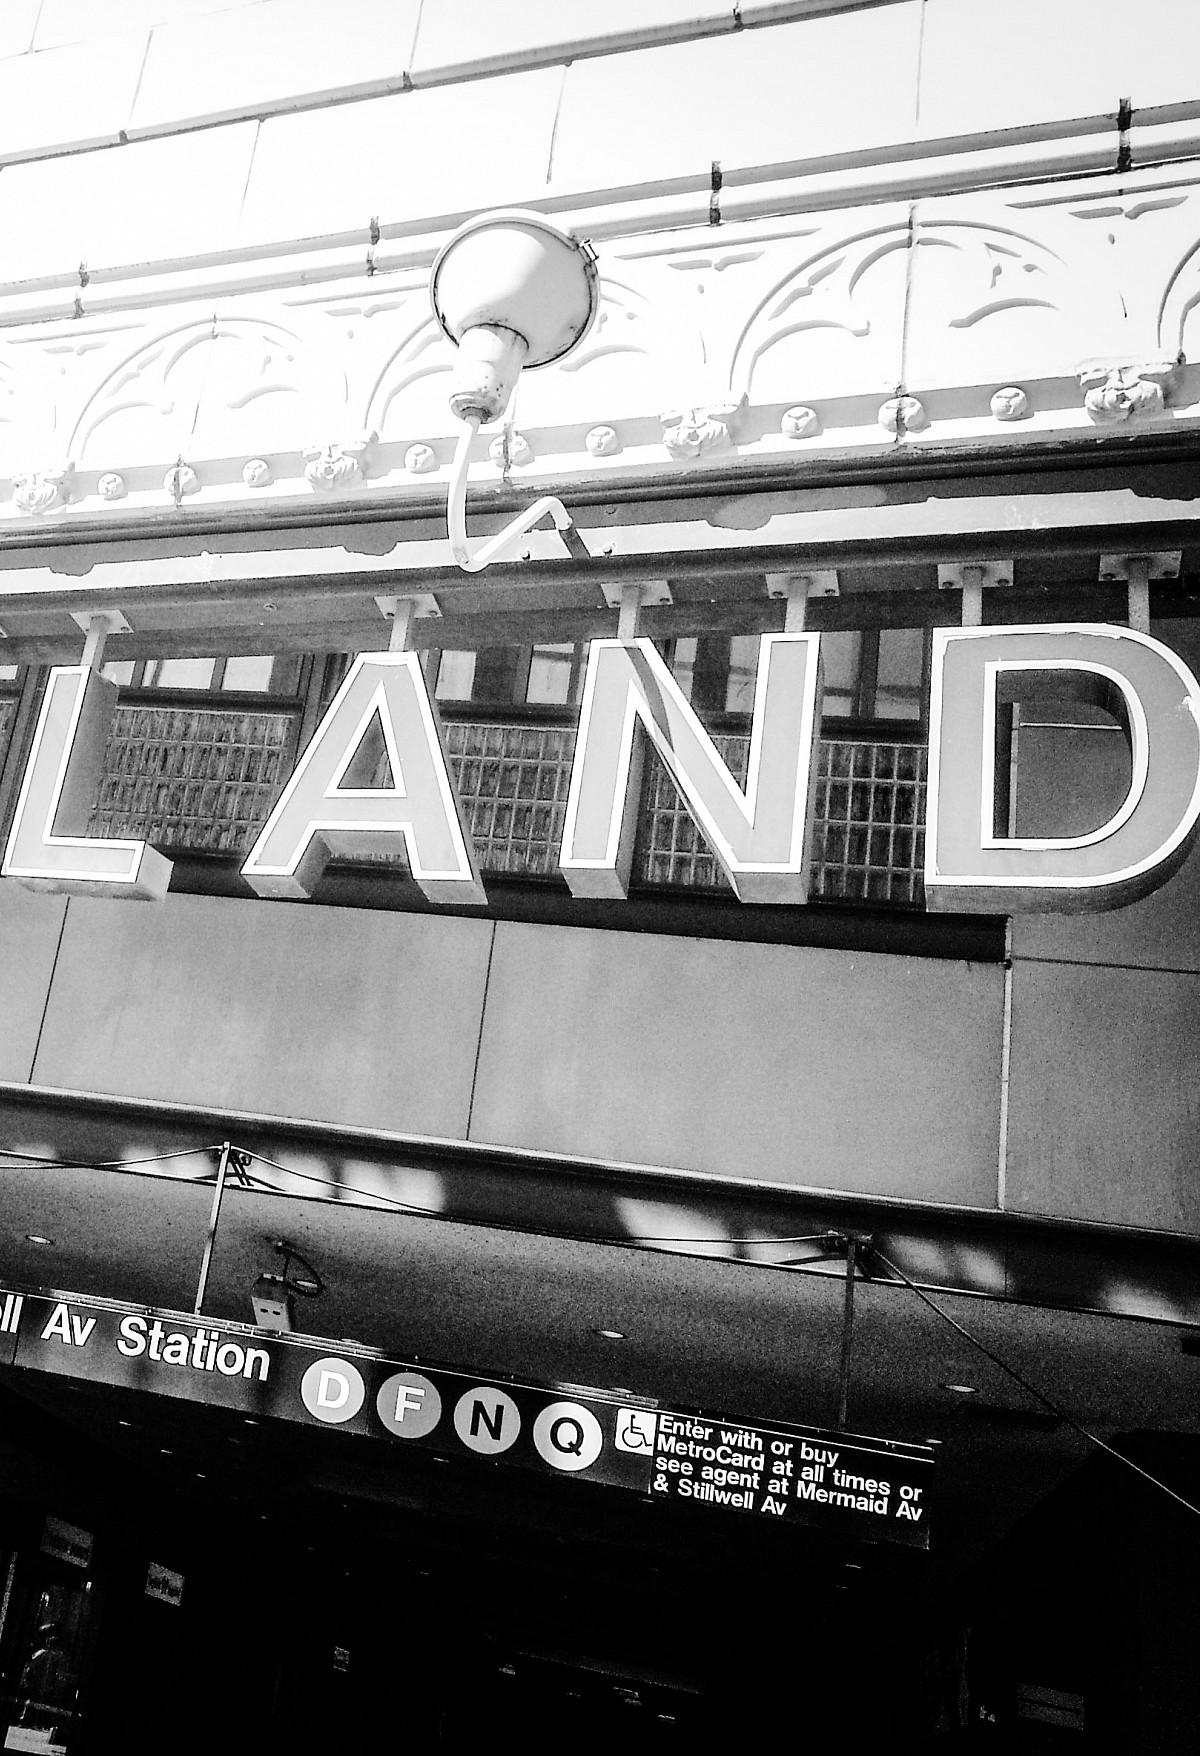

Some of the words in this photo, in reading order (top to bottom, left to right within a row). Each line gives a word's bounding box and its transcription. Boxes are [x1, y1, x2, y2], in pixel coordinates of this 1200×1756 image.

[41, 1302, 96, 1347] Av
[117, 1315, 270, 1381] Station
[316, 1369, 351, 1409] D
[394, 1384, 427, 1423] F
[469, 1400, 505, 1441] N
[550, 1416, 582, 1457] Q
[657, 1434, 765, 1472] MetroCard
[772, 1460, 794, 1477] at
[801, 1466, 825, 1483] all
[832, 1469, 891, 1496] times
[899, 1486, 923, 1502] or
[658, 1414, 713, 1441] Enter
[721, 1430, 763, 1451] with
[771, 1441, 794, 1456] or
[800, 1442, 840, 1468] buy
[652, 1473, 669, 1493] &
[677, 1478, 754, 1510] Stillwell
[761, 1496, 787, 1517] Av
[655, 1456, 694, 1476] see
[701, 1465, 761, 1490] agent
[767, 1478, 790, 1496] at
[797, 1480, 889, 1516] Mermaid
[895, 1501, 923, 1521] Av
